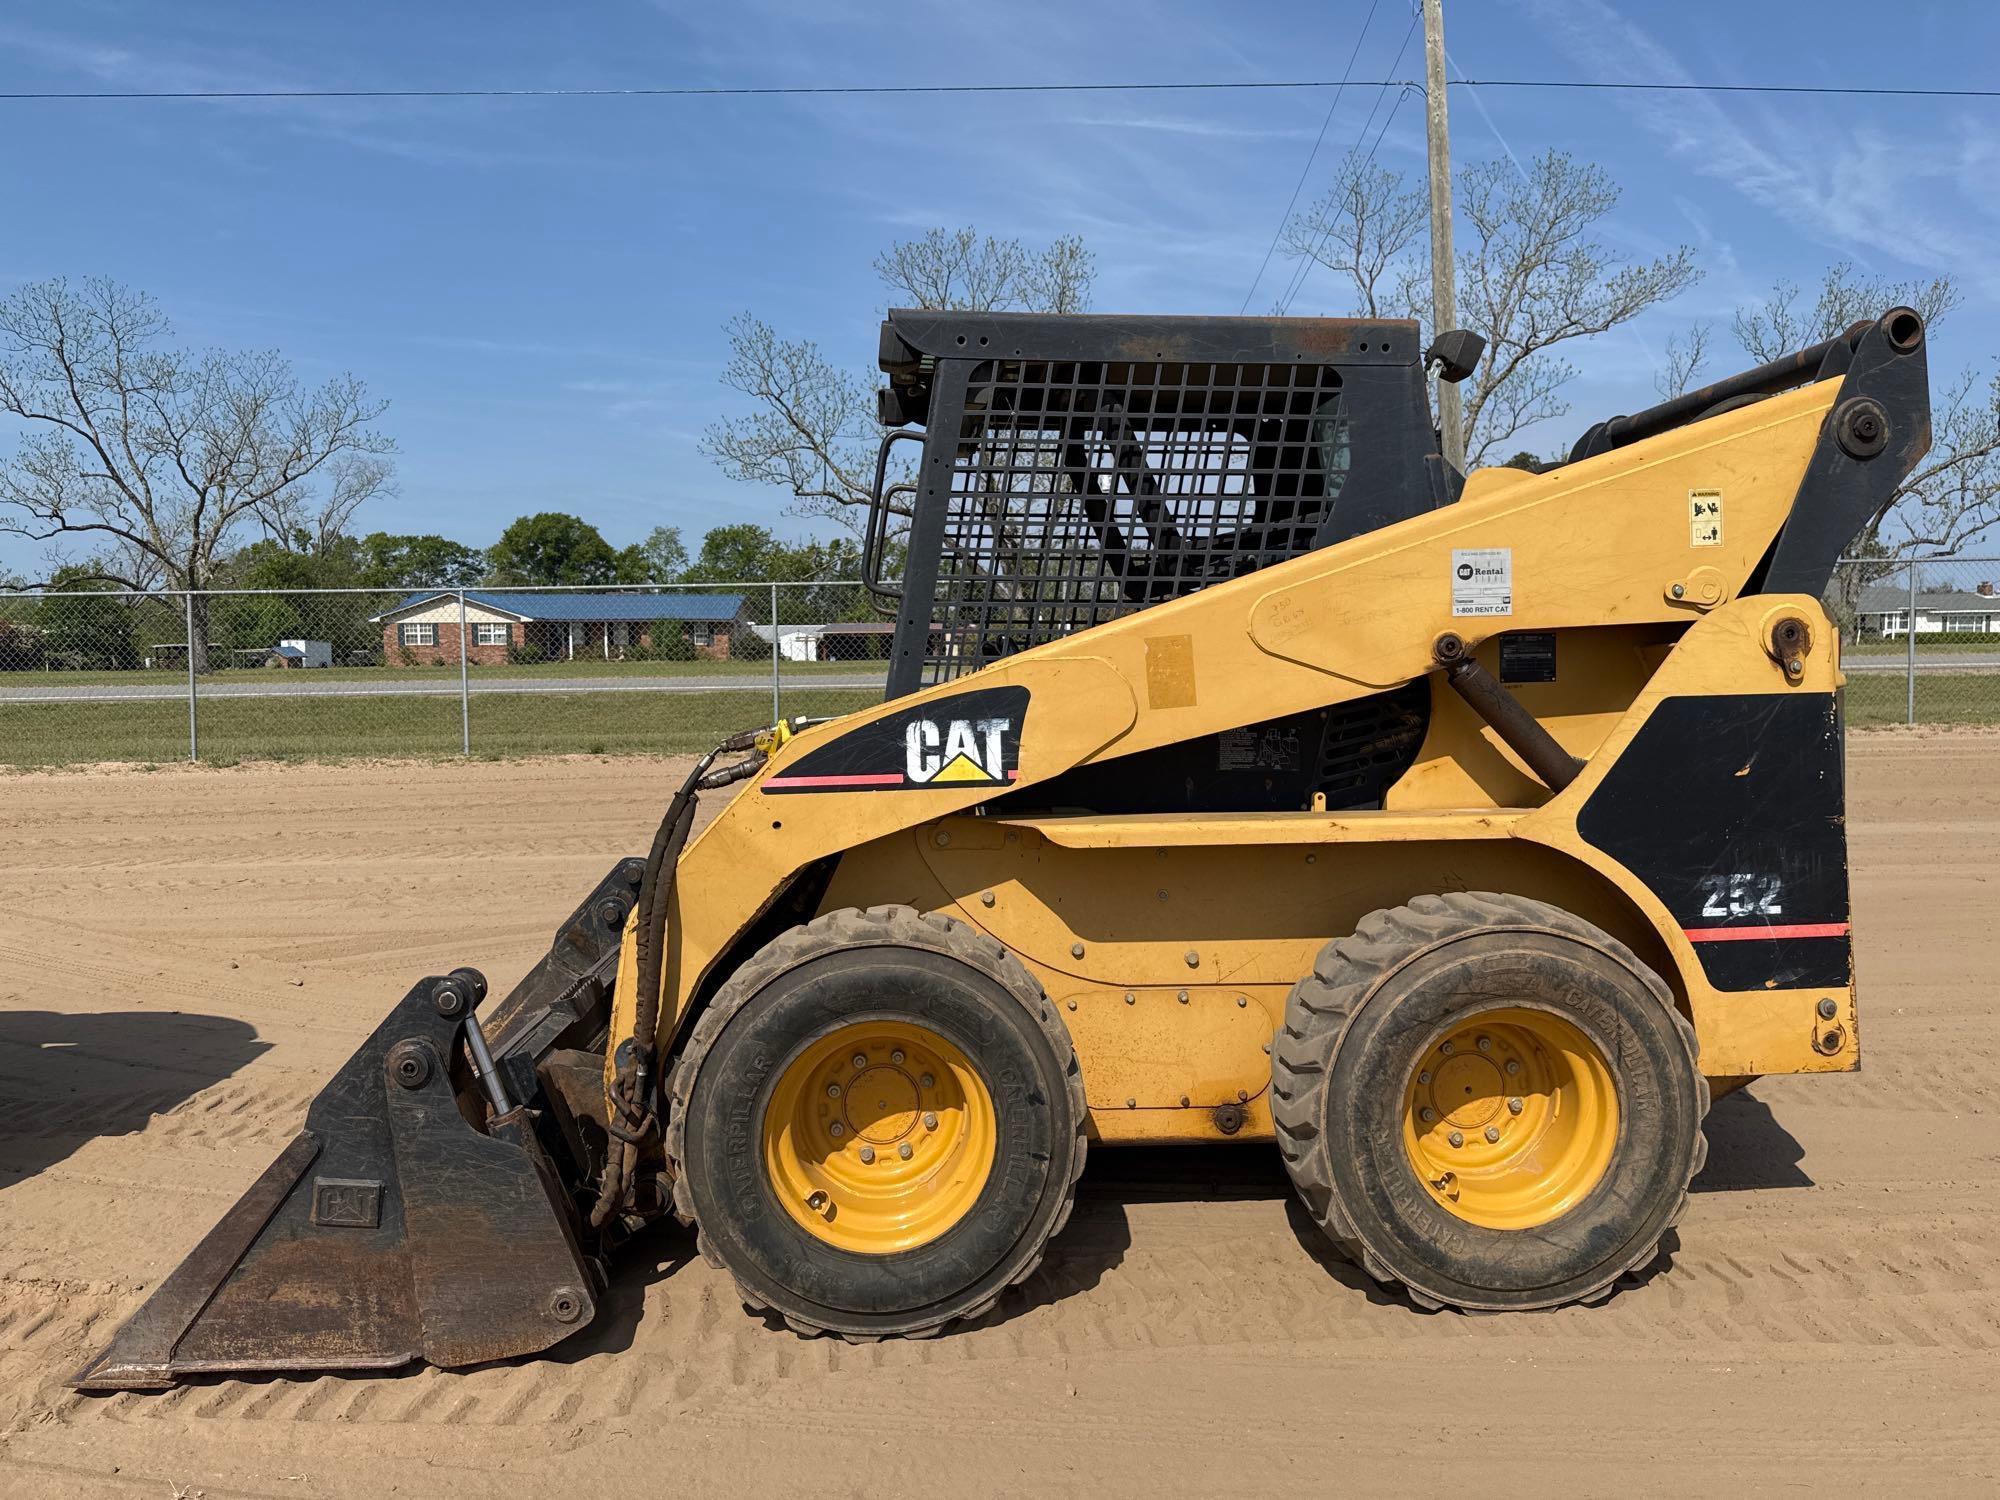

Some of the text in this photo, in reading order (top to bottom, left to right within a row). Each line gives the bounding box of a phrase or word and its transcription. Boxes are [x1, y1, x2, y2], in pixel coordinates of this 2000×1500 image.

[905, 717, 1010, 783] CAT
[1701, 873, 1782, 917] 252
[1565, 988, 1655, 1113] CATERPILLAR
[726, 1054, 774, 1222] CATERPILLAR
[319, 1186, 376, 1223] CAT
